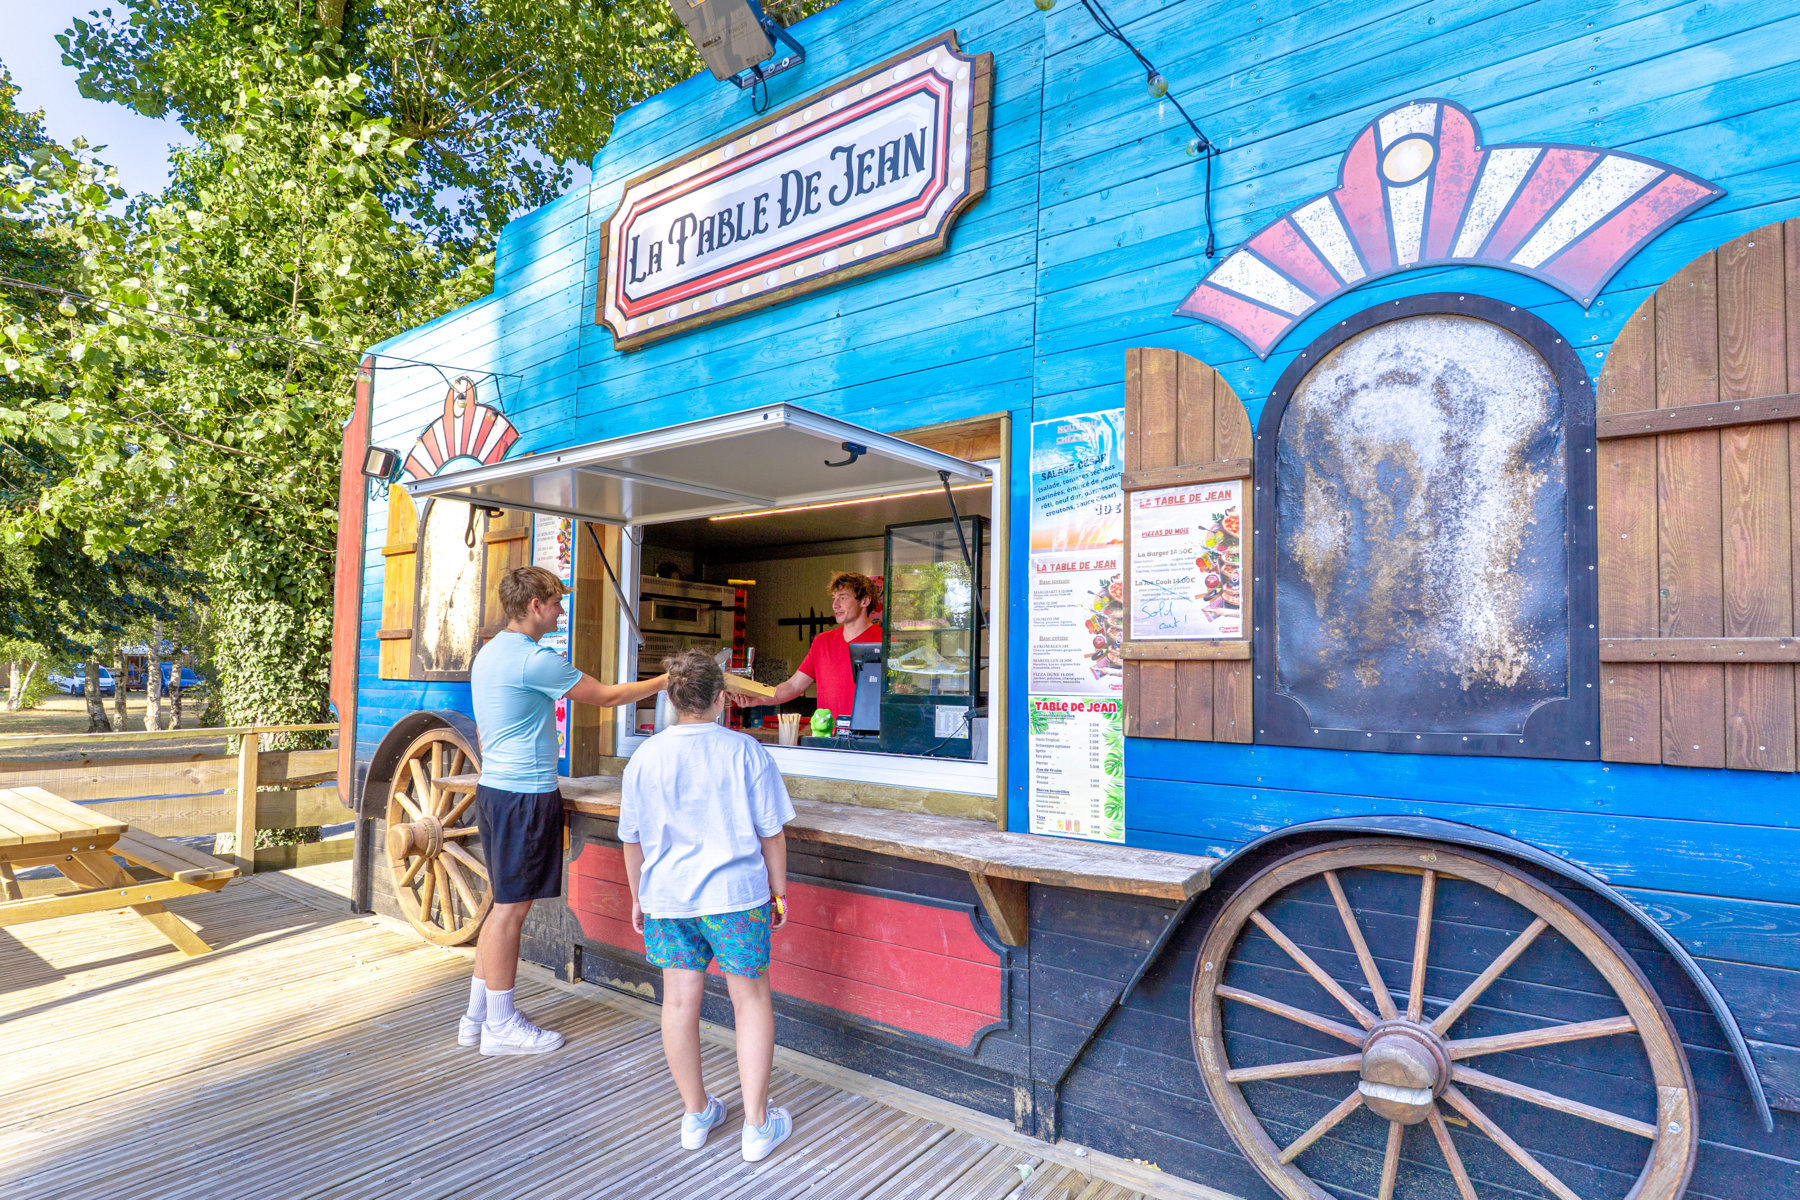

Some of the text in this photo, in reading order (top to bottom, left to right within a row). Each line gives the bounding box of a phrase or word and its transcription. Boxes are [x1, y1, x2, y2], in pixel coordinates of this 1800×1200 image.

[629, 234, 663, 284] LA
[777, 169, 822, 229] DE
[828, 126, 928, 207] JEAN
[1041, 463, 1076, 481] SALADE
[1154, 494, 1186, 506] TABLE
[1189, 493, 1202, 503] DE
[1205, 489, 1232, 501] JEAN
[1141, 529, 1163, 537] PIZZAS
[1174, 527, 1189, 535] MOIS
[1146, 550, 1169, 558] Burger
[1036, 559, 1117, 572] LA TABLE DE JEAN
[1141, 601, 1173, 620] Sold
